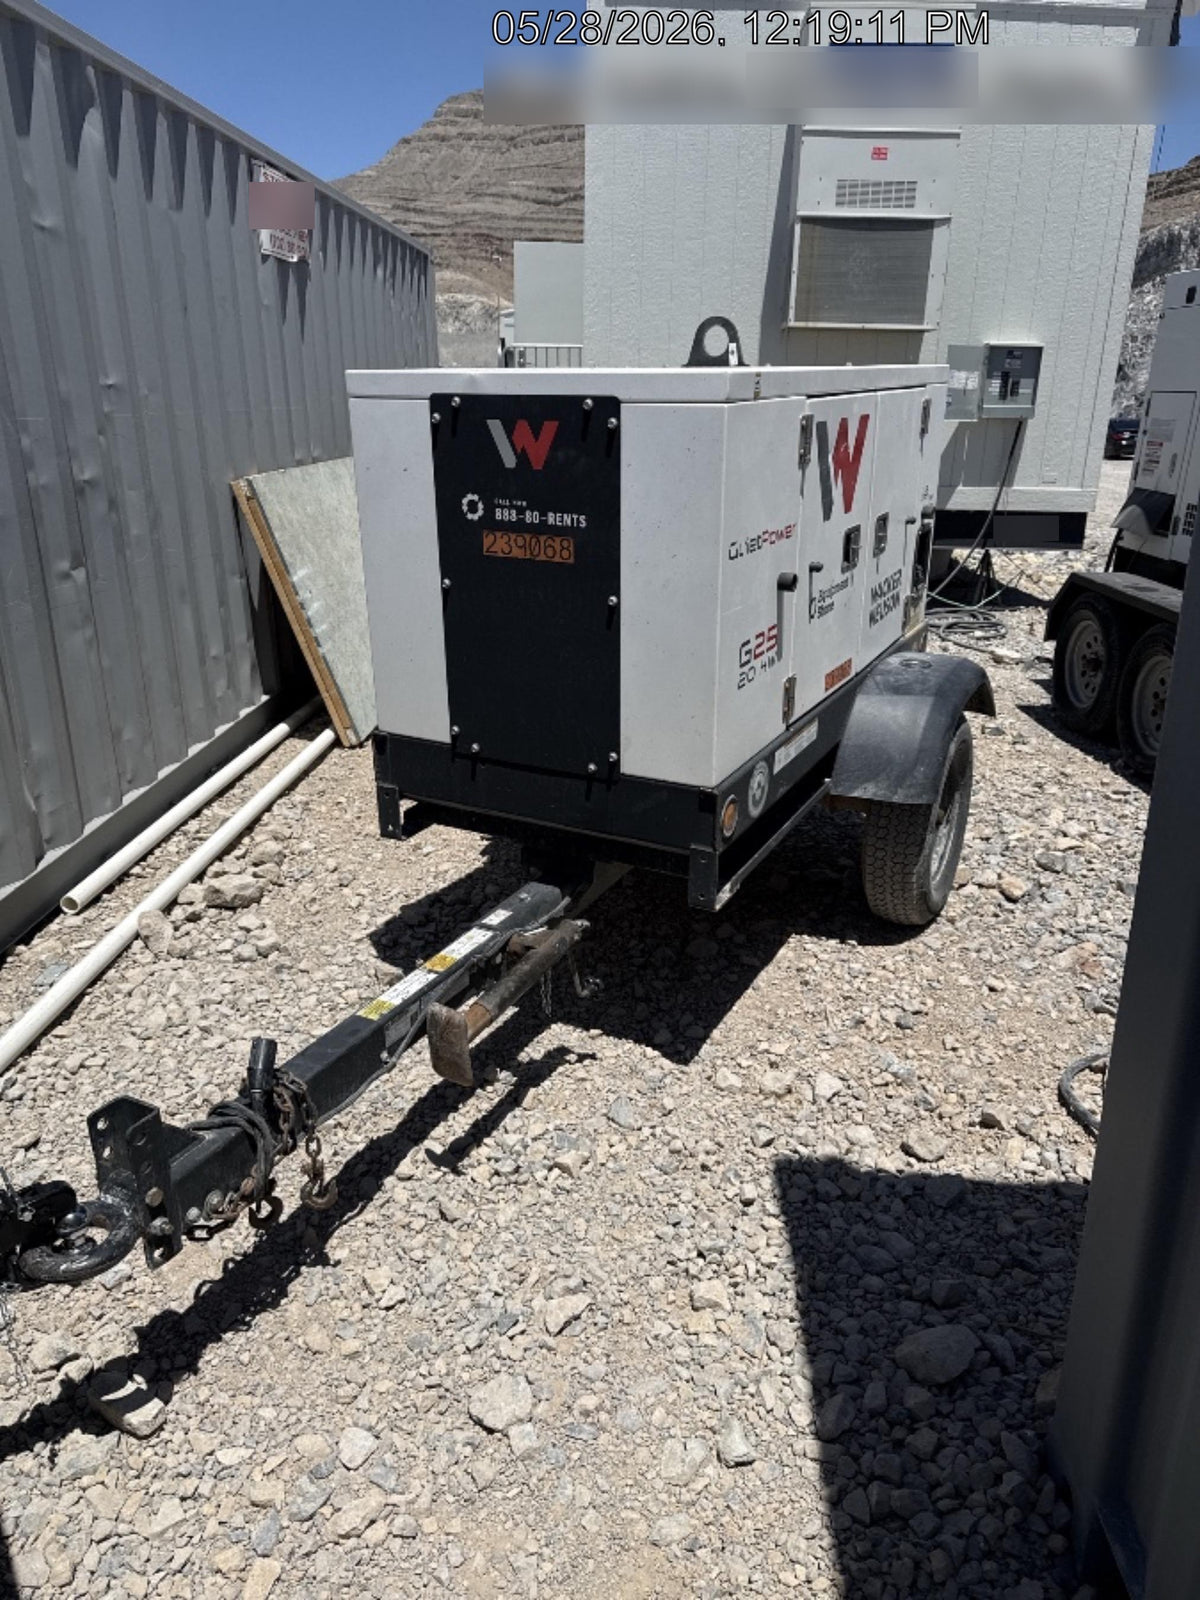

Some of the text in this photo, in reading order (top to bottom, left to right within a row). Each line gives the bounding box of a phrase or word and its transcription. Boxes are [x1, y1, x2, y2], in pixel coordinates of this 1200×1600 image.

[495, 507, 587, 528] 888-80-RENTS
[484, 532, 572, 560] 239068
[739, 623, 778, 668] G25
[737, 665, 756, 690] 20
